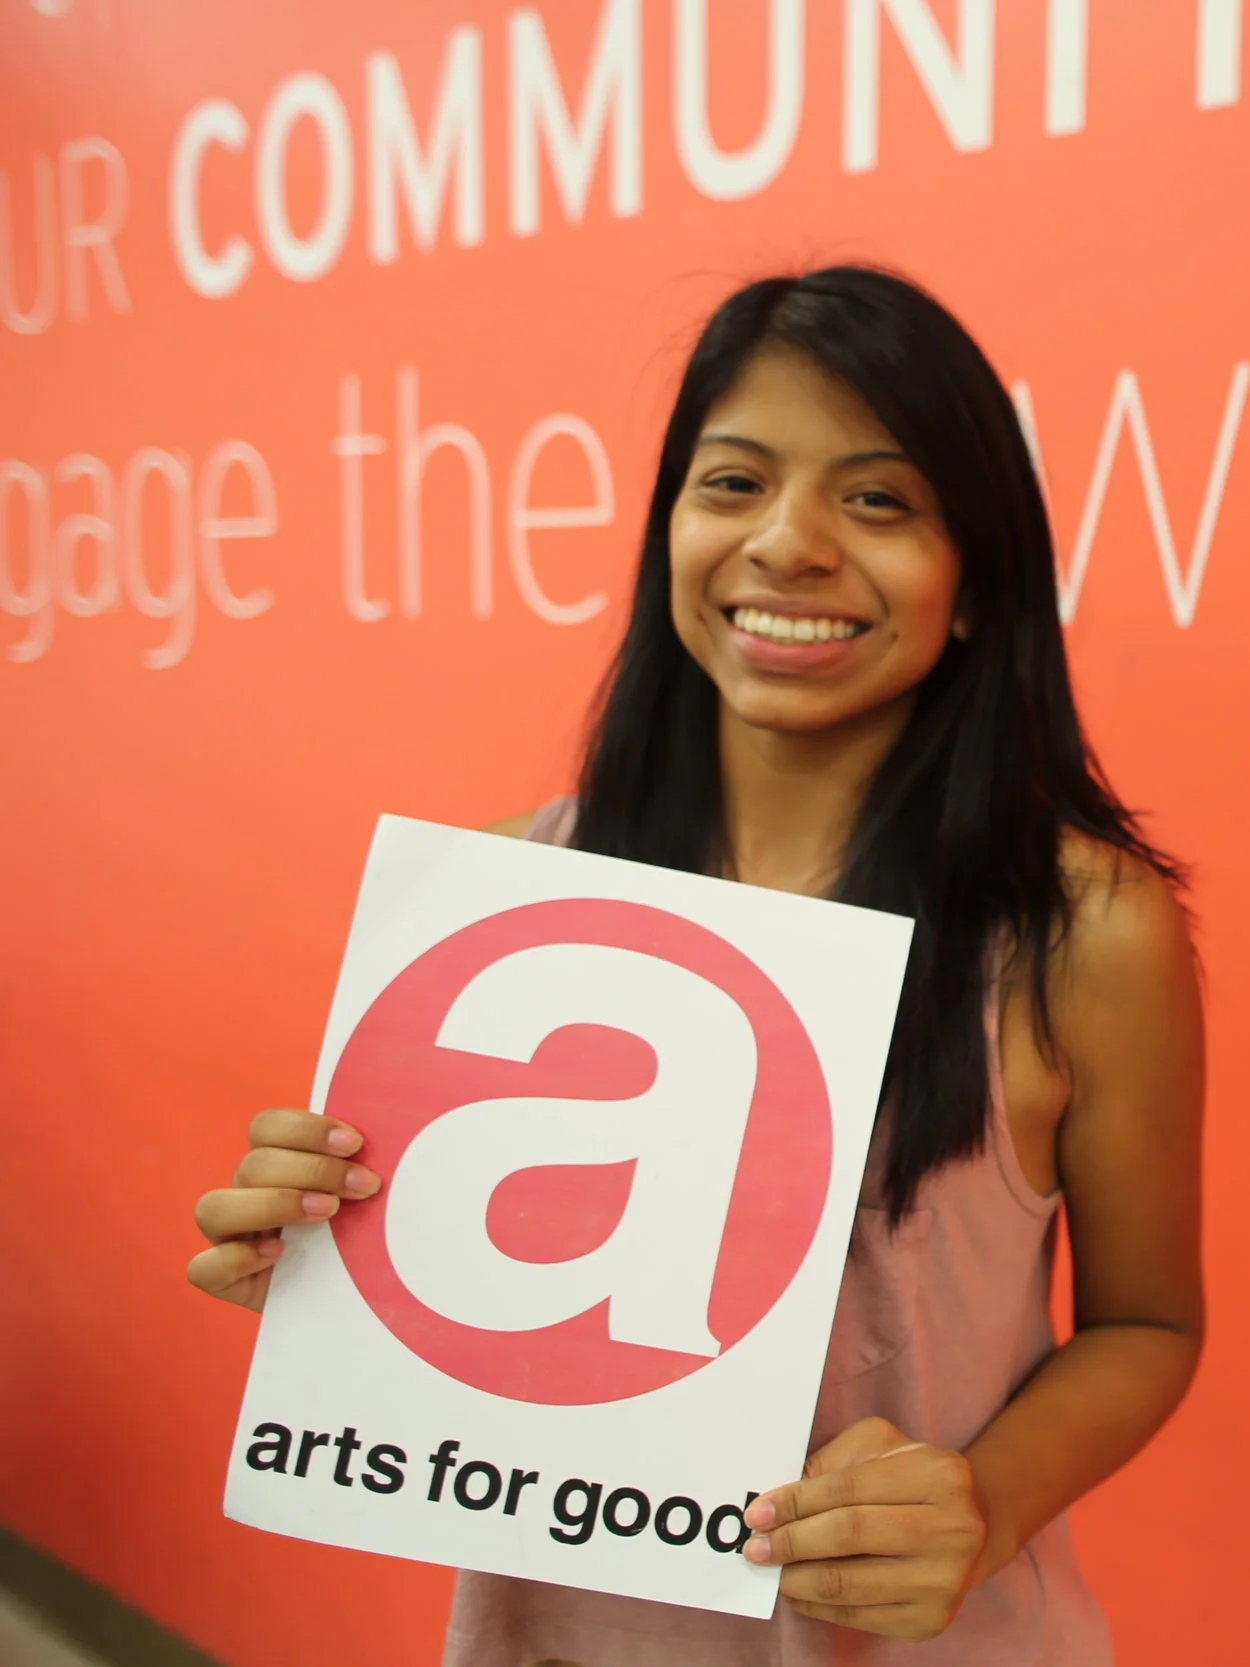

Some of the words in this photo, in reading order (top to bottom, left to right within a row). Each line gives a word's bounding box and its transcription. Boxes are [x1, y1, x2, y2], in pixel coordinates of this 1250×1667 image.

[331, 366, 615, 625] the
[384, 942, 759, 1359] a
[245, 1422, 407, 1495] arts
[427, 1440, 540, 1517] for
[549, 1477, 760, 1555] good
